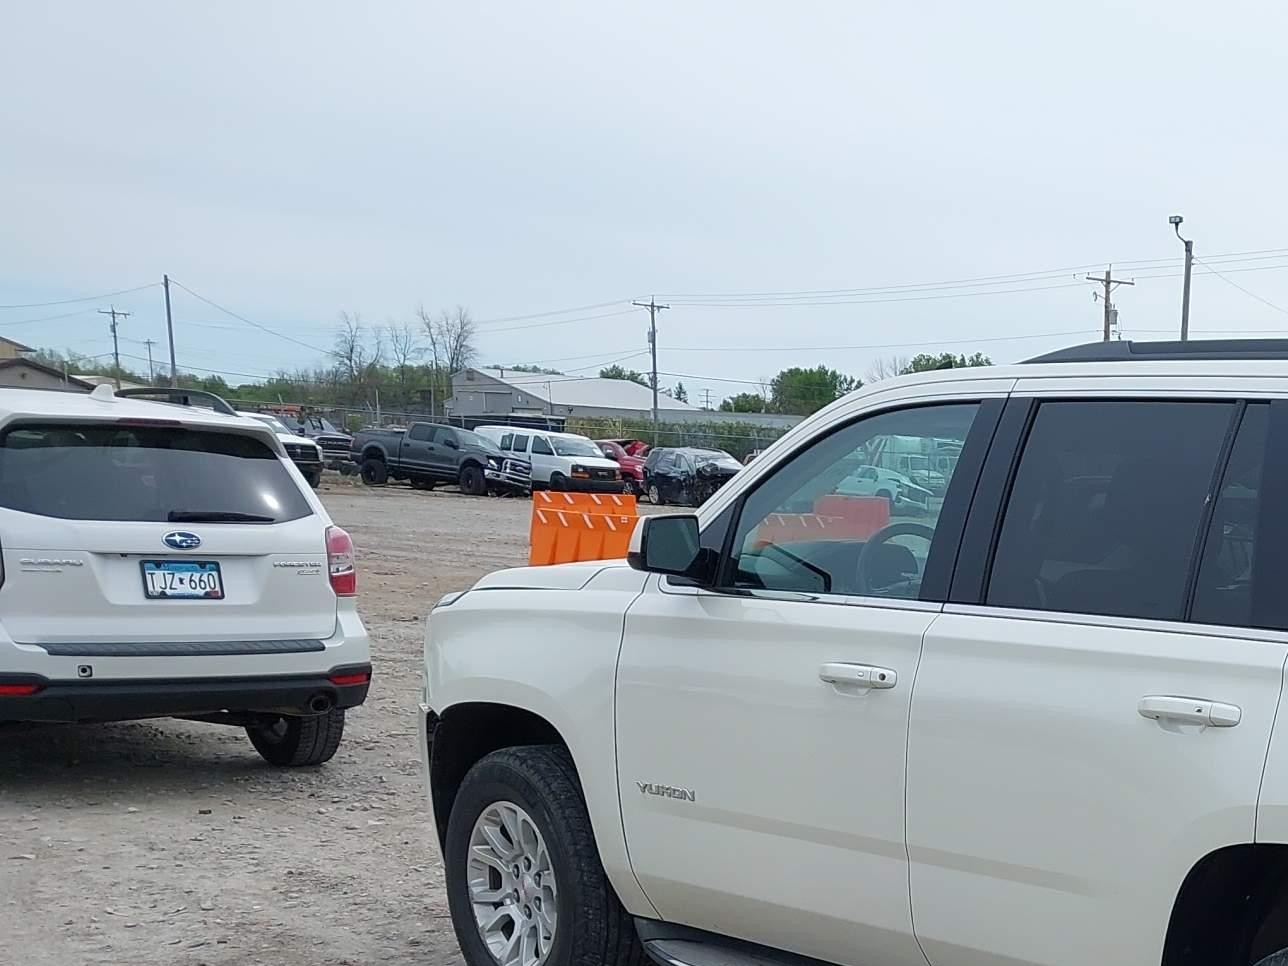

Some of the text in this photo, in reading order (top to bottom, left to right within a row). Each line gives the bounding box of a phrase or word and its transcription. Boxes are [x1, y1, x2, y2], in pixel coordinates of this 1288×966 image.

[147, 572, 217, 591] TJZ 660
[633, 780, 696, 802] YUKON
